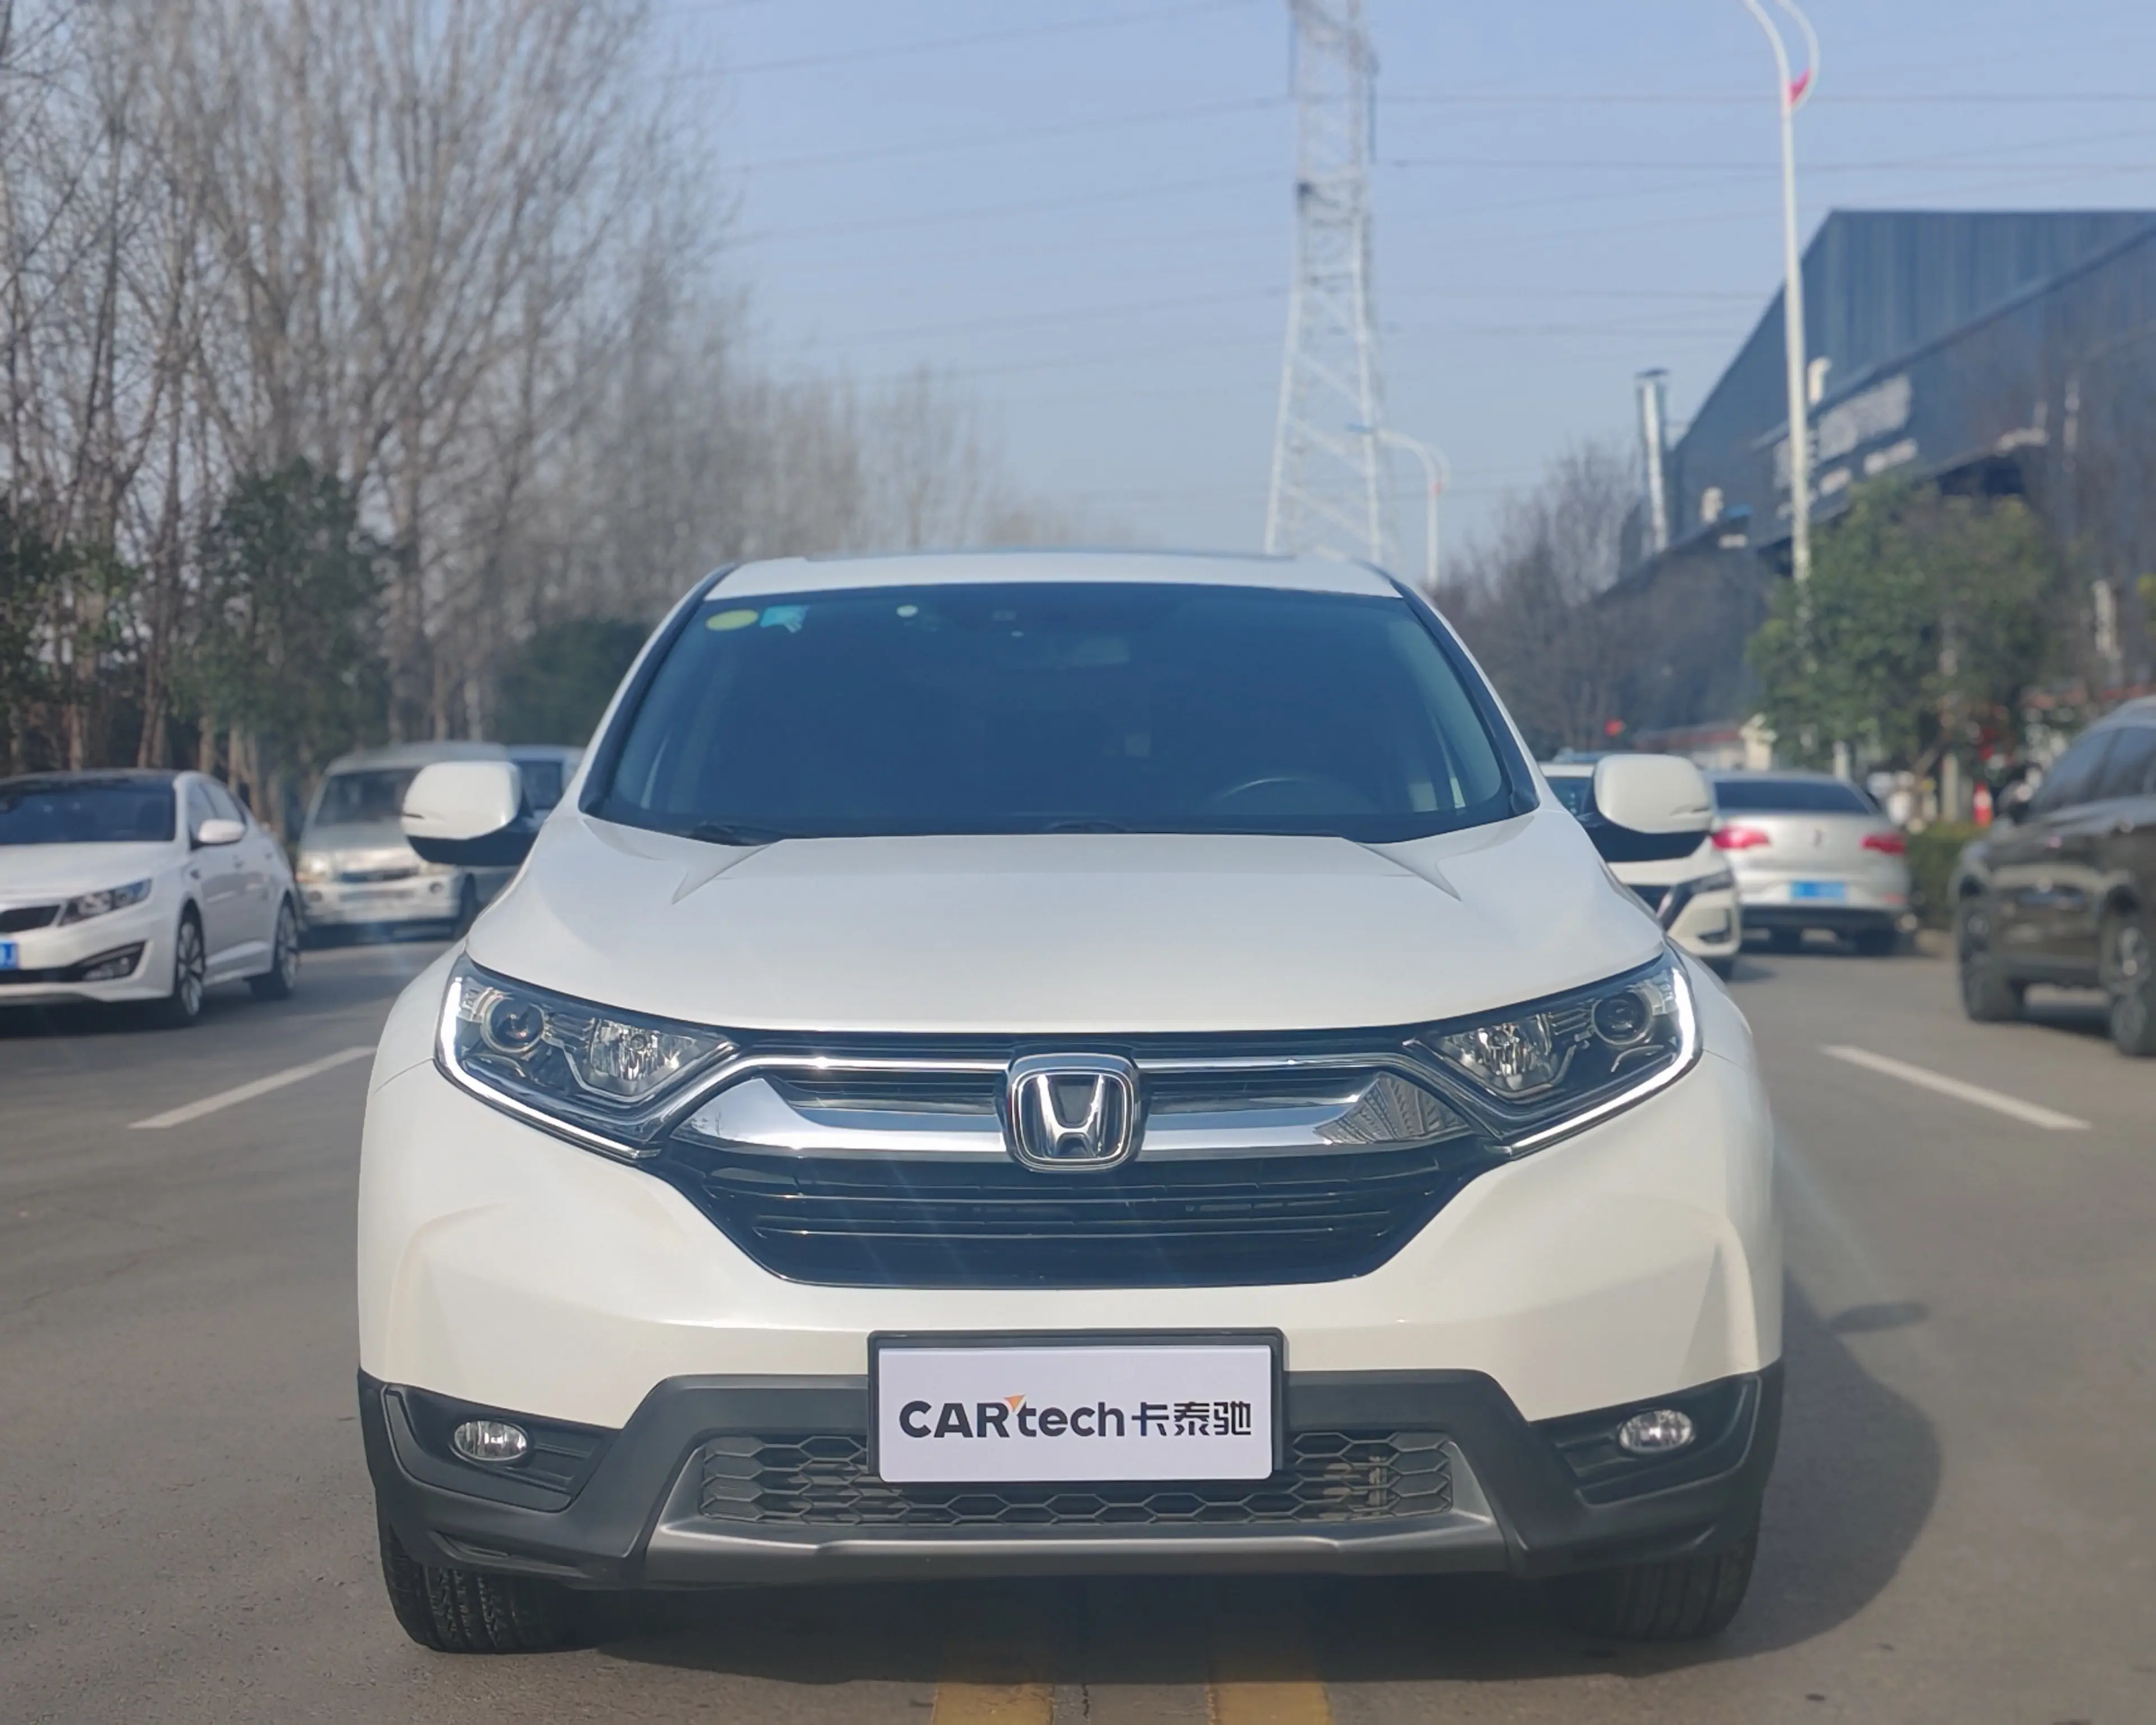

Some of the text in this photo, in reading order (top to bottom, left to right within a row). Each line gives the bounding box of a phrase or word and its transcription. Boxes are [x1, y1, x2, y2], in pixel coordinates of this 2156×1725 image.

[899, 1400, 1251, 1438] CARtech 卡泰驰
